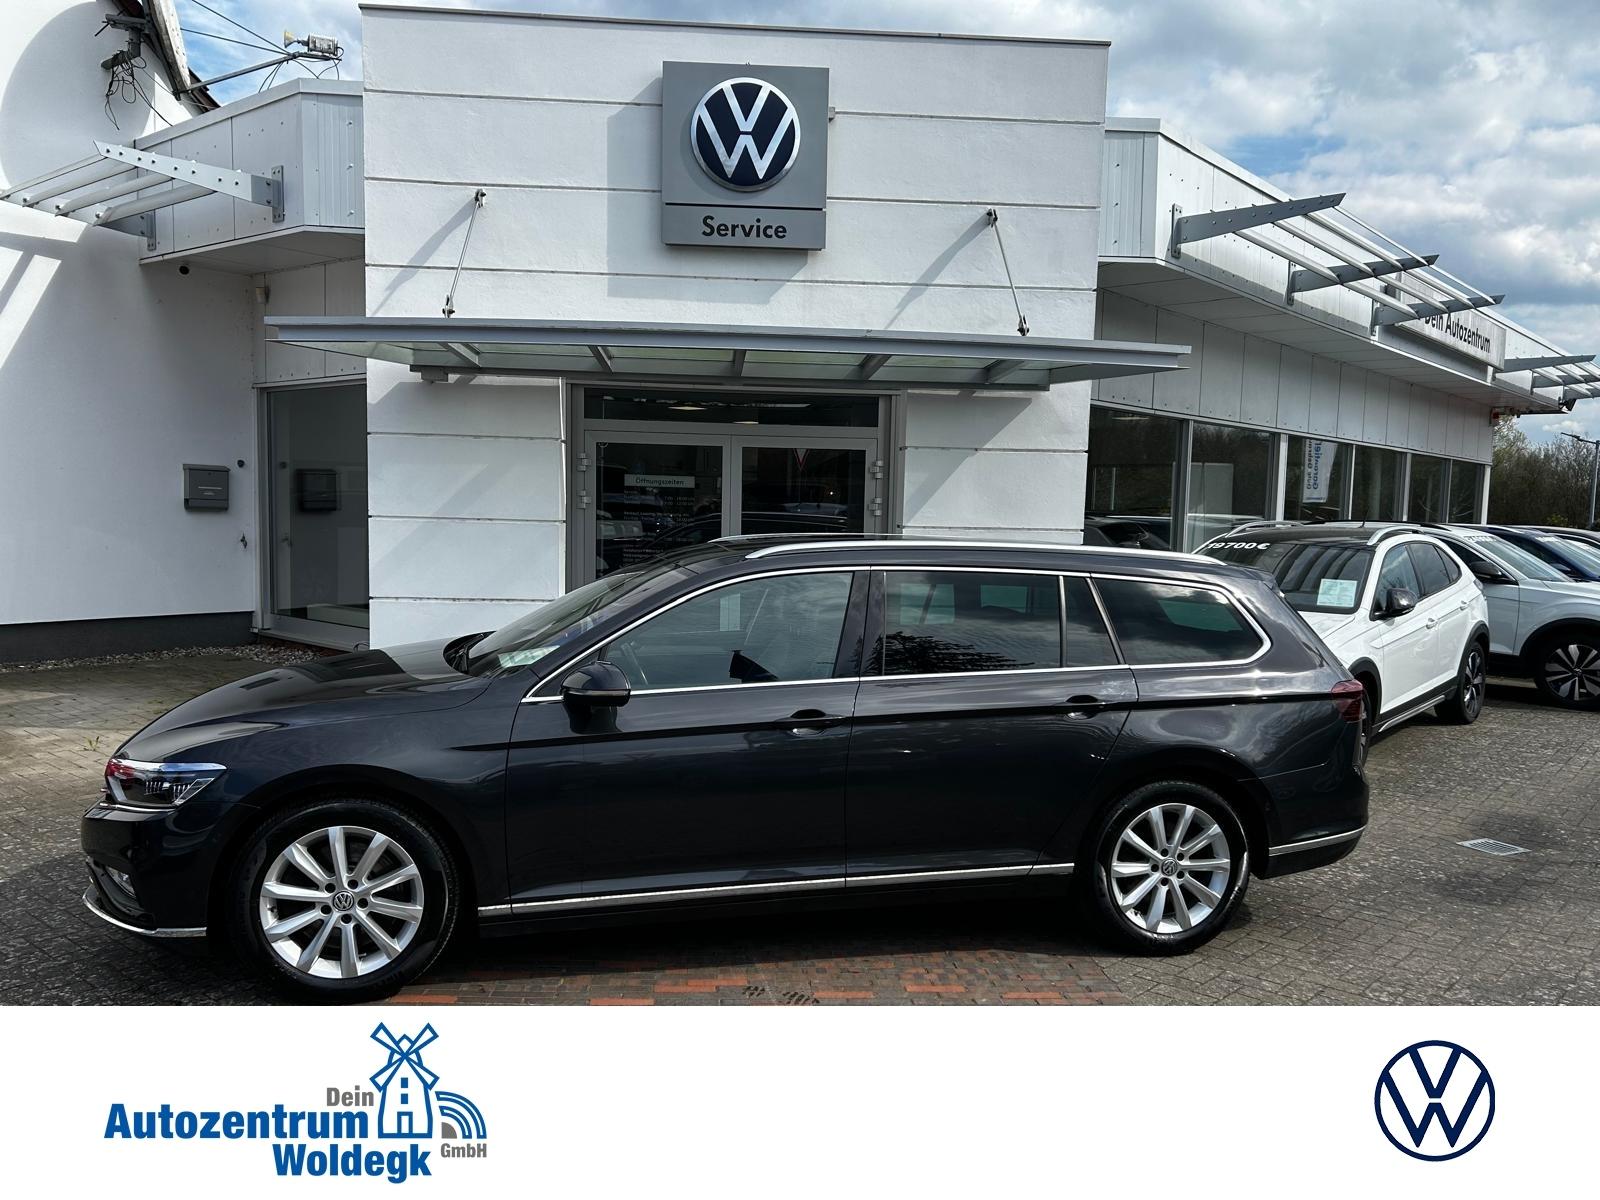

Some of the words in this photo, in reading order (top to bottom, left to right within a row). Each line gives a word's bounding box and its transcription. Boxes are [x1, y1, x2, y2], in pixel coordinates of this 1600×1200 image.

[692, 79, 799, 185] VW
[701, 214, 788, 239] Service
[1445, 312, 1491, 353] Autozentrum
[635, 476, 685, 486] Öffnungszeiten
[333, 891, 354, 911] VW
